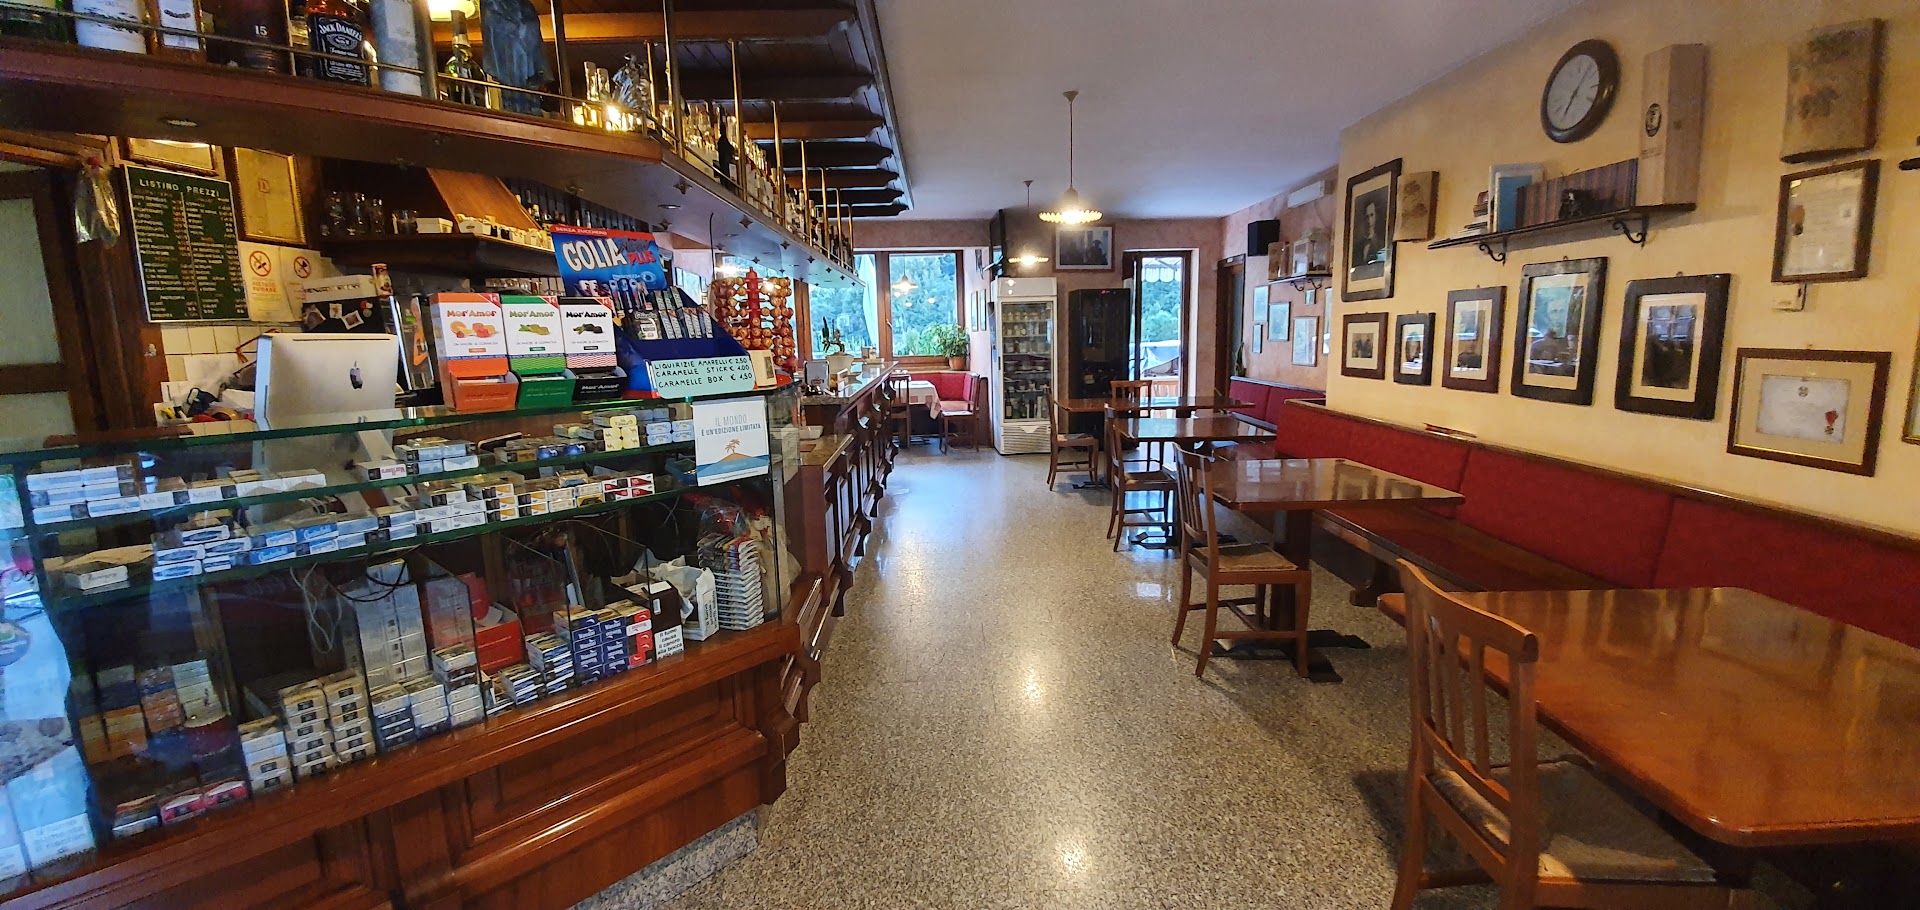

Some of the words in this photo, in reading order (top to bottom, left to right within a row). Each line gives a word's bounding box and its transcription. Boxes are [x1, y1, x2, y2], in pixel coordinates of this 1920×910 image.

[254, 25, 268, 36] 15
[318, 23, 337, 35] JACK
[139, 178, 180, 191] LISTINO
[186, 185, 220, 198] PREZZI
[576, 228, 608, 236] ZUCCHERO
[562, 238, 628, 272] GOLIA
[627, 250, 657, 265] PLUS
[447, 309, 497, 318] Mor'Amor
[509, 310, 555, 318] Mor'Amor
[565, 311, 608, 319] Mor'Amor
[654, 360, 696, 370] LIQUIRIZIE
[655, 368, 700, 378] CARAMELLE
[706, 365, 728, 374] STICK
[658, 377, 703, 388] CARAMELLE
[707, 375, 724, 384] BOX
[715, 417, 721, 427] IL
[723, 414, 748, 426] MONDO
[740, 423, 761, 432] LIMITATA
[661, 634, 677, 643] causa
[663, 638, 681, 648] cancro
[667, 642, 683, 652] bocca
